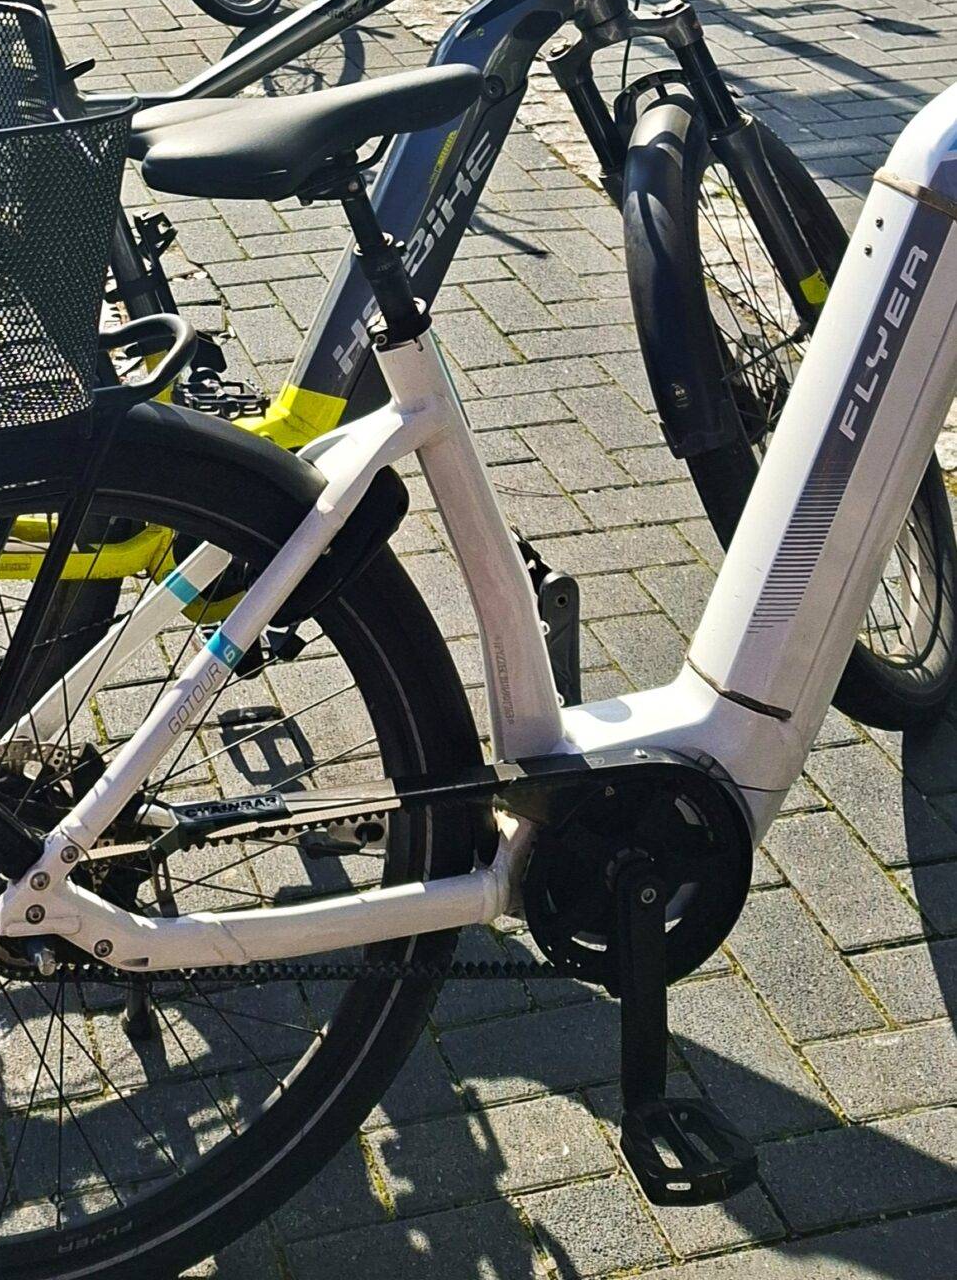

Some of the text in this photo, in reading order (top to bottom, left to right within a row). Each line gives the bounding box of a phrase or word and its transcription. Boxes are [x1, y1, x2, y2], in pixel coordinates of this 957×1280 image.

[838, 244, 929, 442] FLYER
[223, 645, 236, 663] 6
[168, 662, 222, 735] GOTOUR
